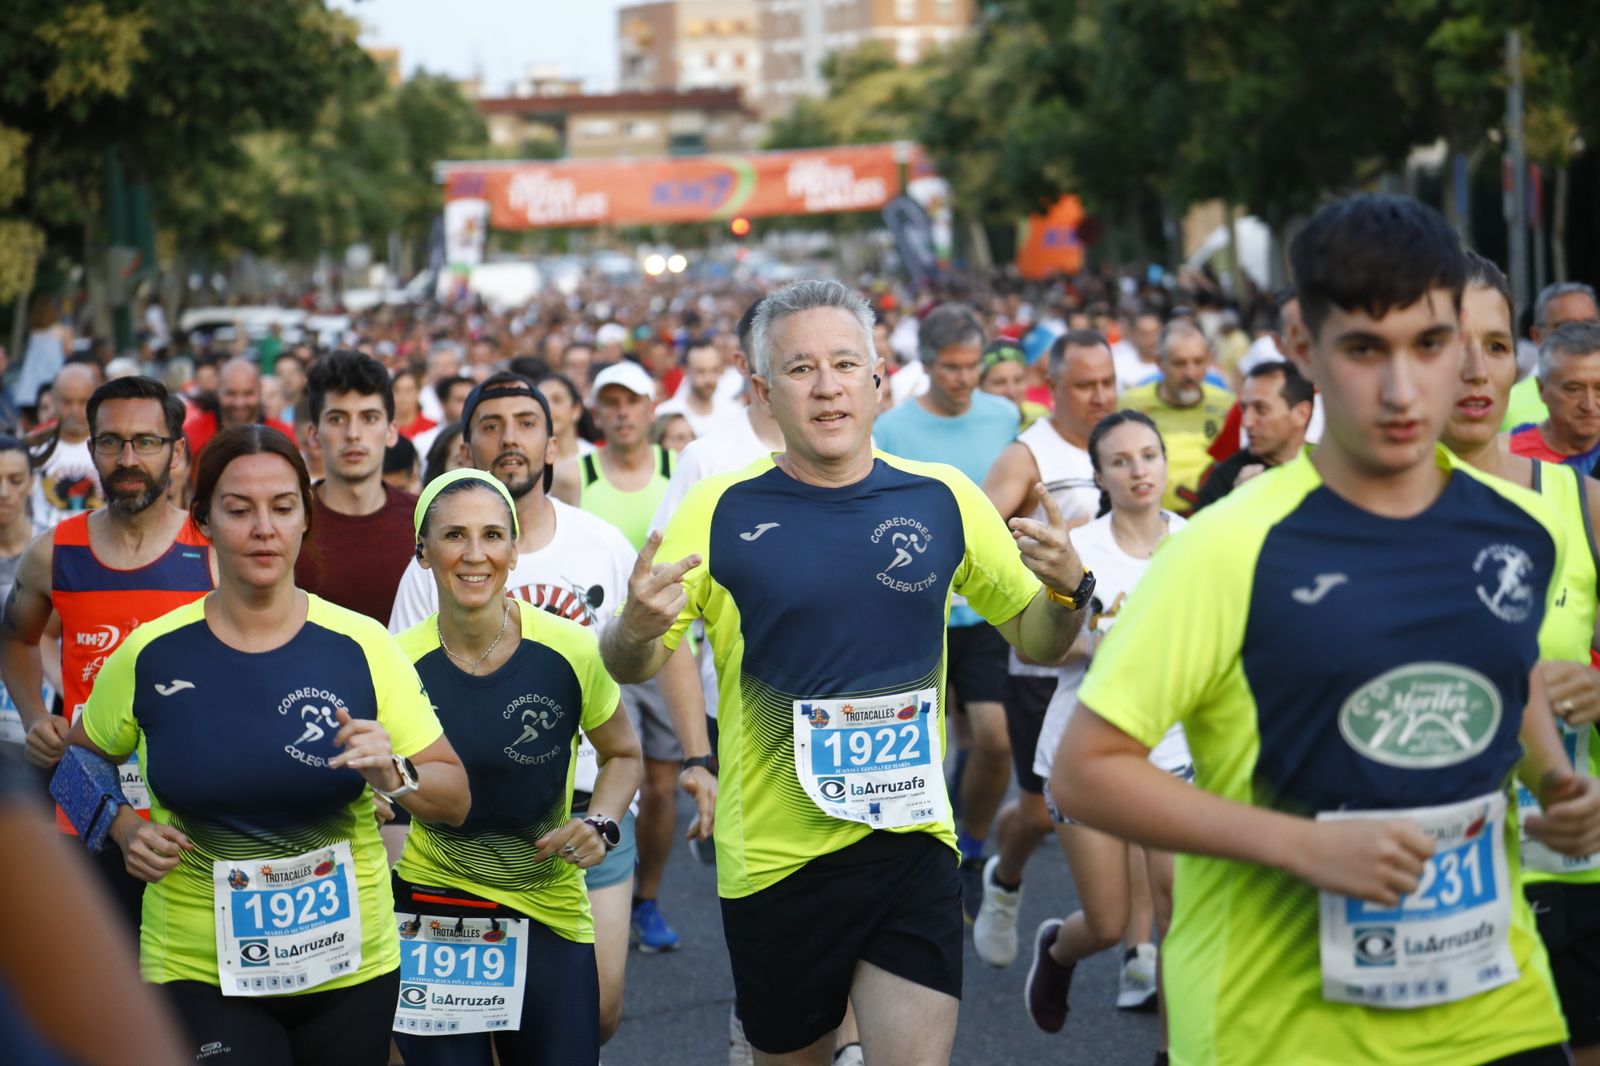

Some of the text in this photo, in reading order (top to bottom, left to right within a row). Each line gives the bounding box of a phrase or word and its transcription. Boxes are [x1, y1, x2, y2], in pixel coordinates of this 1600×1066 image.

[871, 516, 932, 543] CORREDORES
[876, 572, 937, 592] COLEGUITAS
[502, 693, 565, 720] CORREDORES
[846, 707, 895, 722] TROTACALLES
[503, 745, 561, 765] COLEGUITAS
[824, 724, 921, 768] 1922
[851, 776, 925, 796] laArruzafa
[265, 865, 312, 883] TROTACALLES
[244, 879, 340, 929] 1923
[274, 931, 345, 959] laArruzafa
[411, 943, 505, 980] 1919
[431, 992, 505, 1006] laArruzafa
